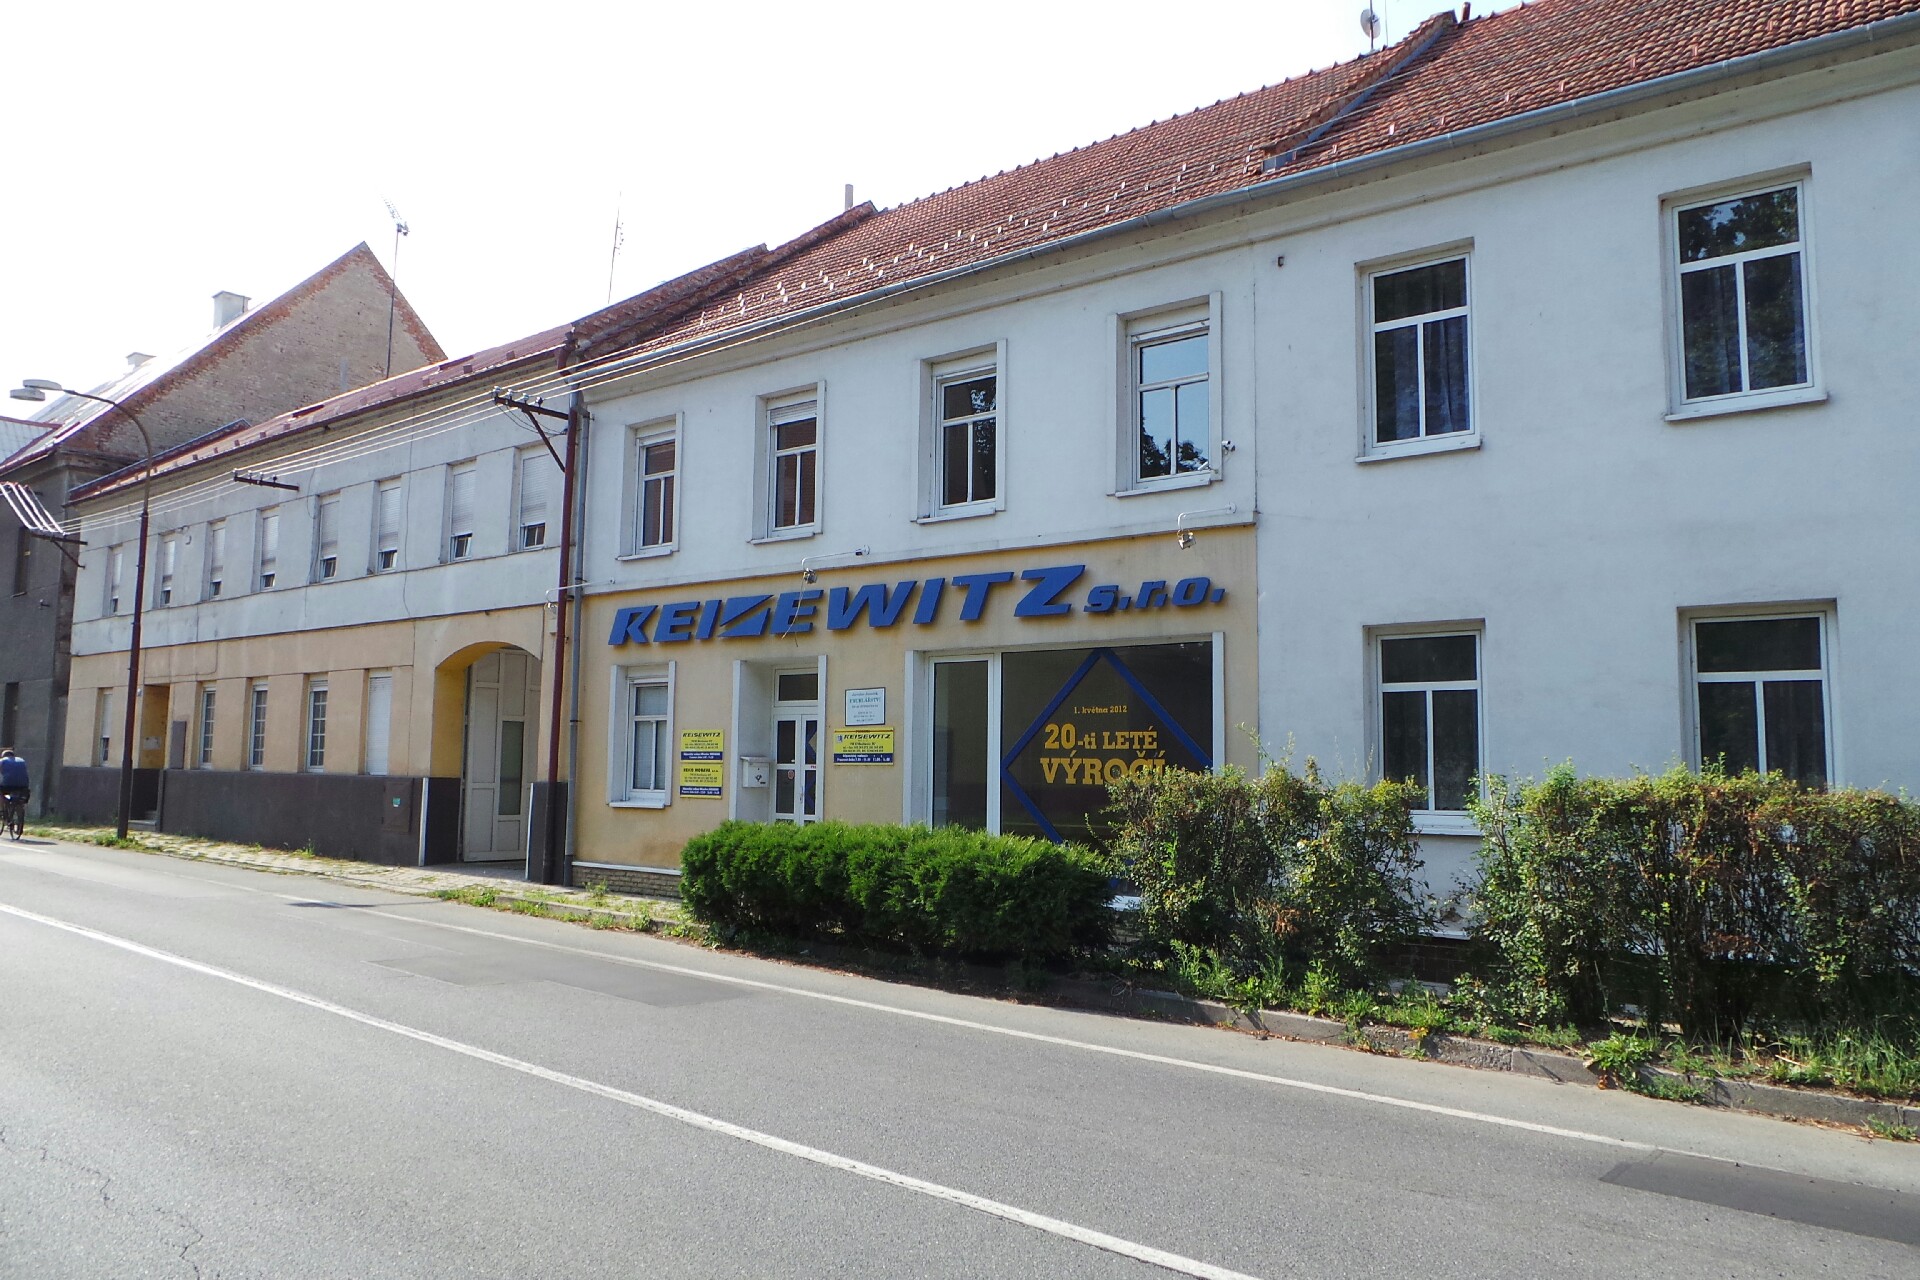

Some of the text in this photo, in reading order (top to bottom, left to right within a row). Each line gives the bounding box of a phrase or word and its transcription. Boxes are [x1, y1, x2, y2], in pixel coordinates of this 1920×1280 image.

[1074, 706, 1081, 714] 1.
[1110, 705, 1128, 713] 2012
[1103, 726, 1158, 749] LETÉ
